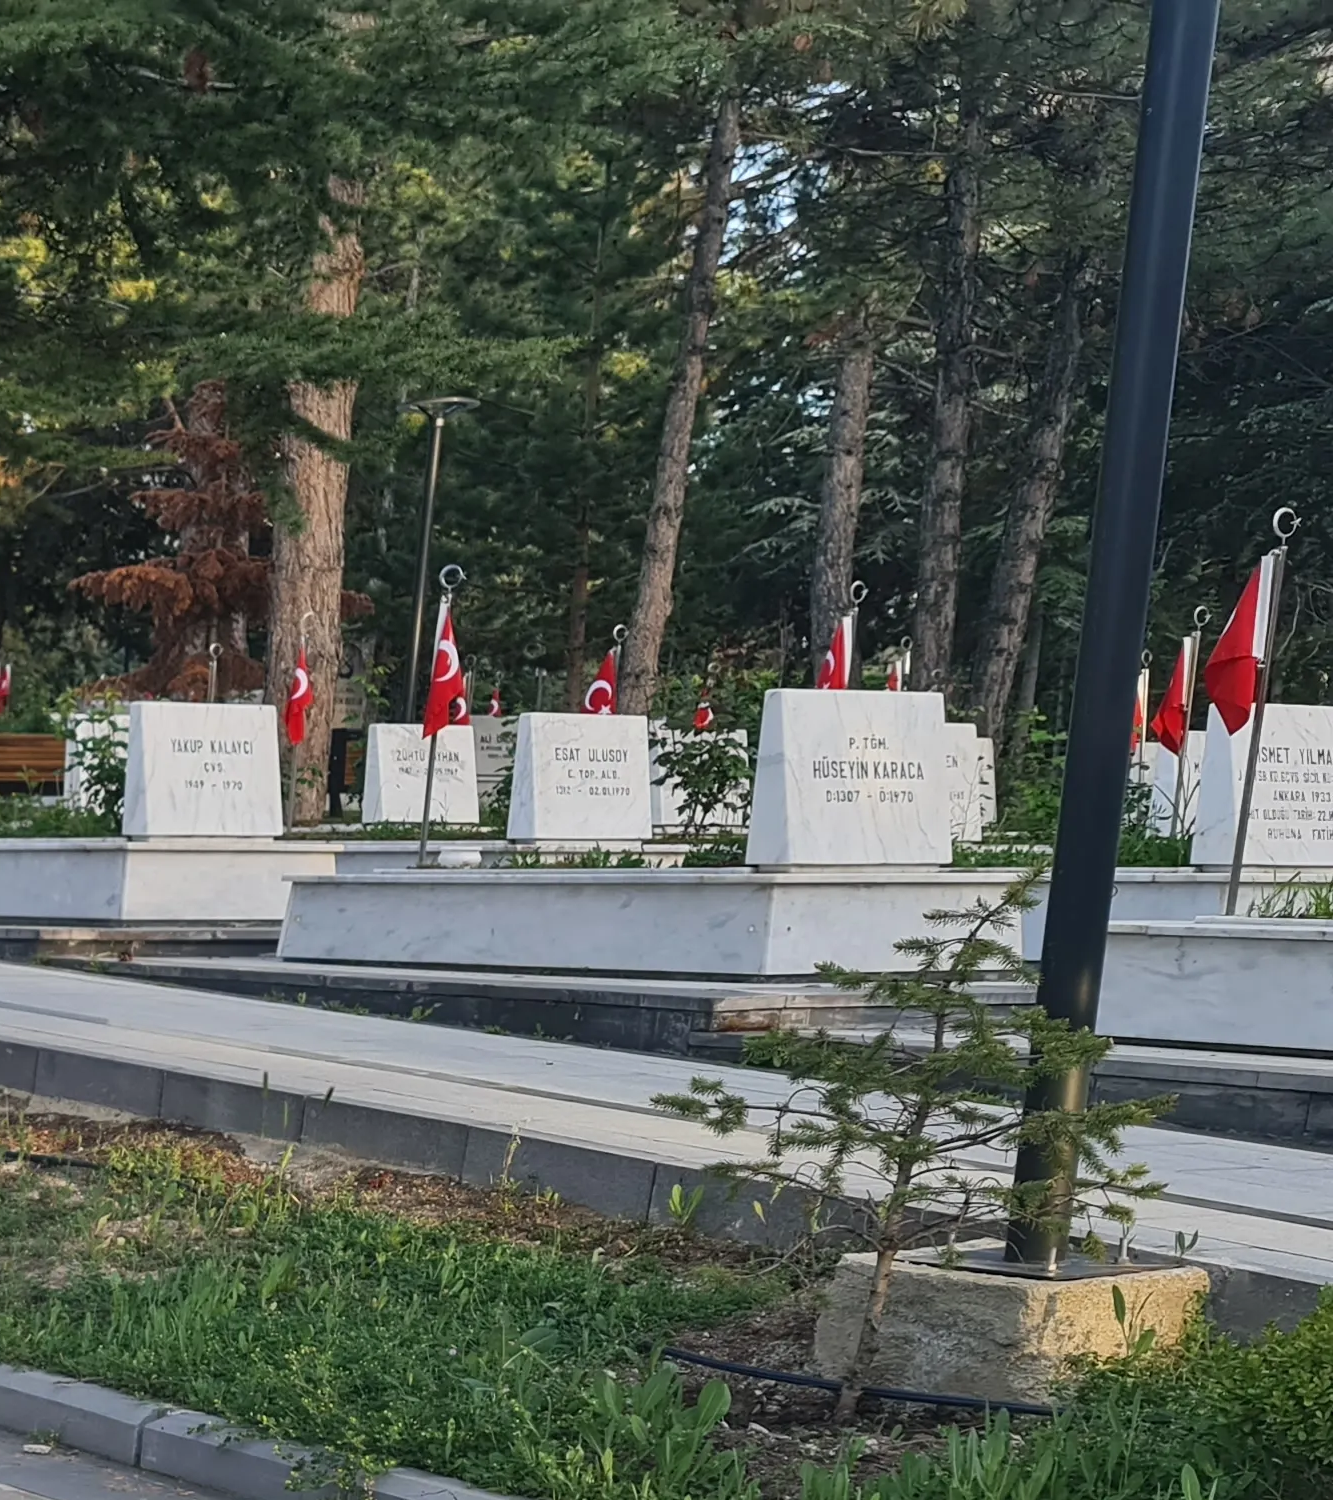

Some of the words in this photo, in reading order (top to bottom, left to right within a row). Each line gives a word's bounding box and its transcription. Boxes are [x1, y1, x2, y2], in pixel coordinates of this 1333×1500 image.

[170, 739, 203, 753] YAKUP
[849, 737, 859, 749] P.
[554, 748, 580, 761] ESAT
[588, 748, 628, 763] ULUSOY
[813, 756, 869, 780] HÜSEYİN
[873, 760, 924, 781] KARACA
